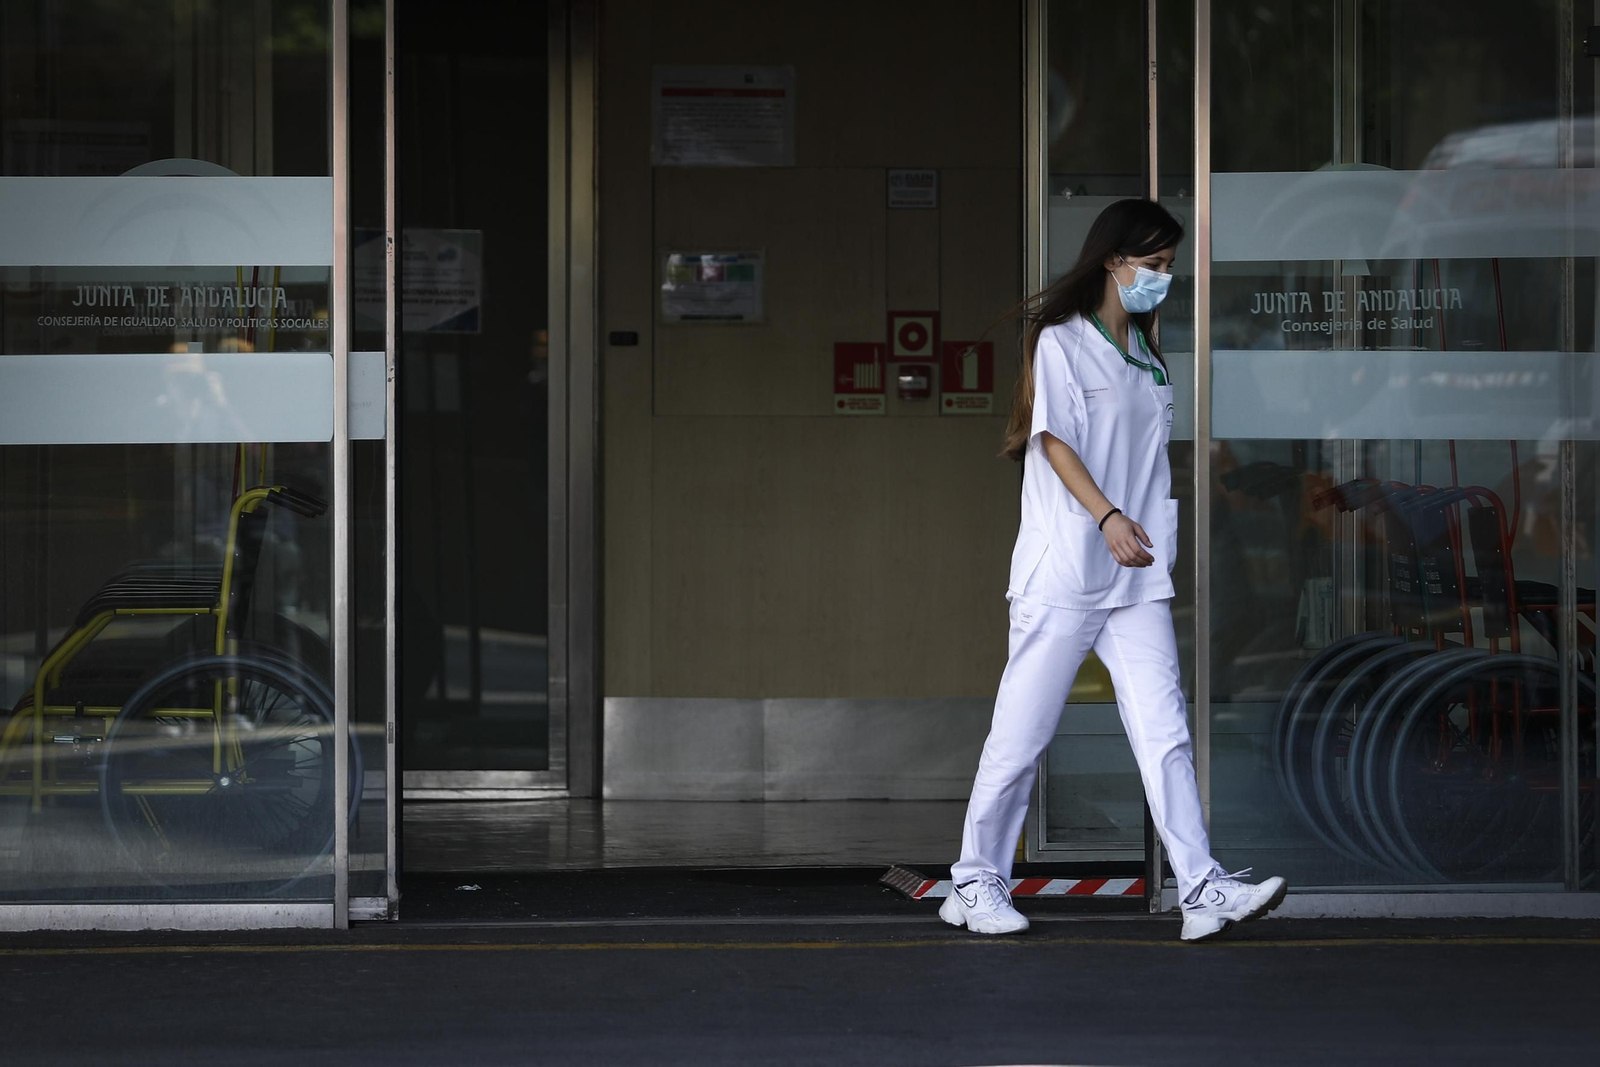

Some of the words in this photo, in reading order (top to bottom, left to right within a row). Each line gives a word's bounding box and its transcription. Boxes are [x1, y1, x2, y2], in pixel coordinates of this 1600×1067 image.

[72, 285, 135, 307] JUNTA
[146, 285, 170, 307] DE
[180, 286, 287, 308] ANDALUCIA
[1250, 292, 1313, 314] JUNTA
[1322, 291, 1346, 313] DE
[1356, 288, 1463, 312] ANDALUCIA
[37, 314, 101, 326] CONSEJERÍA
[103, 316, 118, 326] DE
[120, 316, 178, 328] IGUALDAD,
[226, 315, 279, 328] POLÍTICAS
[280, 318, 329, 329] SOCIALES
[1367, 317, 1387, 330] de
[1390, 316, 1434, 330] Salud
